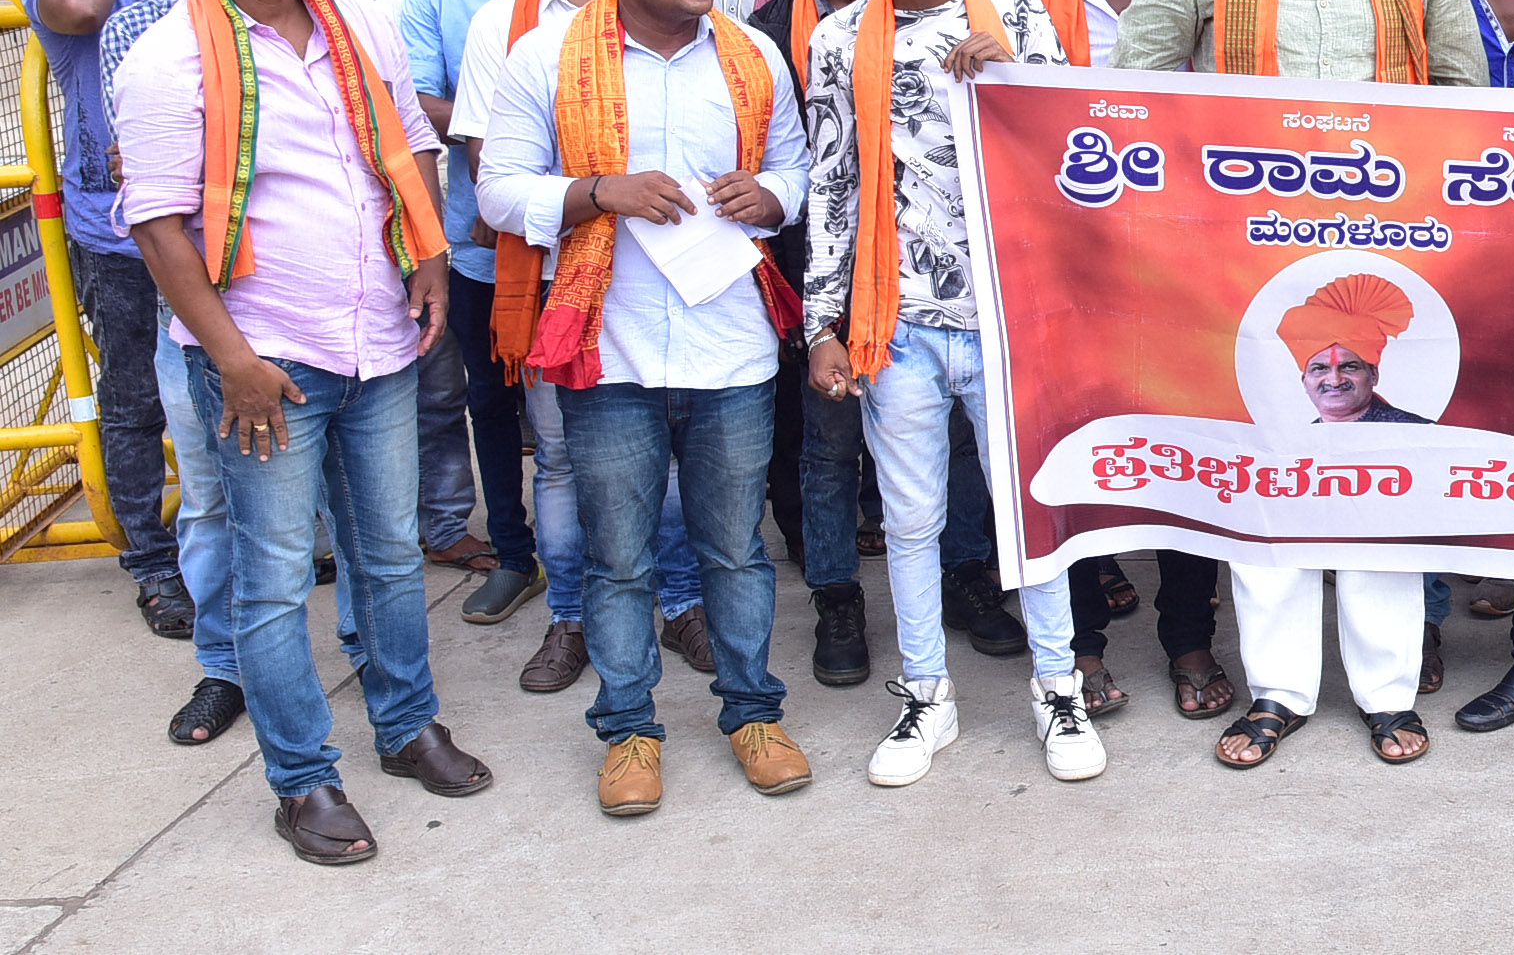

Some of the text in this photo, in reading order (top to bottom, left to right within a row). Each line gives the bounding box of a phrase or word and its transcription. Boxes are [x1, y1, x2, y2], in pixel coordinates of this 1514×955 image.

[1088, 100, 1149, 120] ಸೇವಾ
[1282, 110, 1371, 133] ಸಂಘಟನೆ
[1059, 130, 1163, 205] ಶ್ರೀ
[1205, 144, 1404, 200] ರಾಮ
[1249, 214, 1451, 251] ಮಂಗಳೂರು
[15, 277, 31, 312] BE
[1092, 437, 1413, 502] ಪ್ರತಿಭಟನಾ
